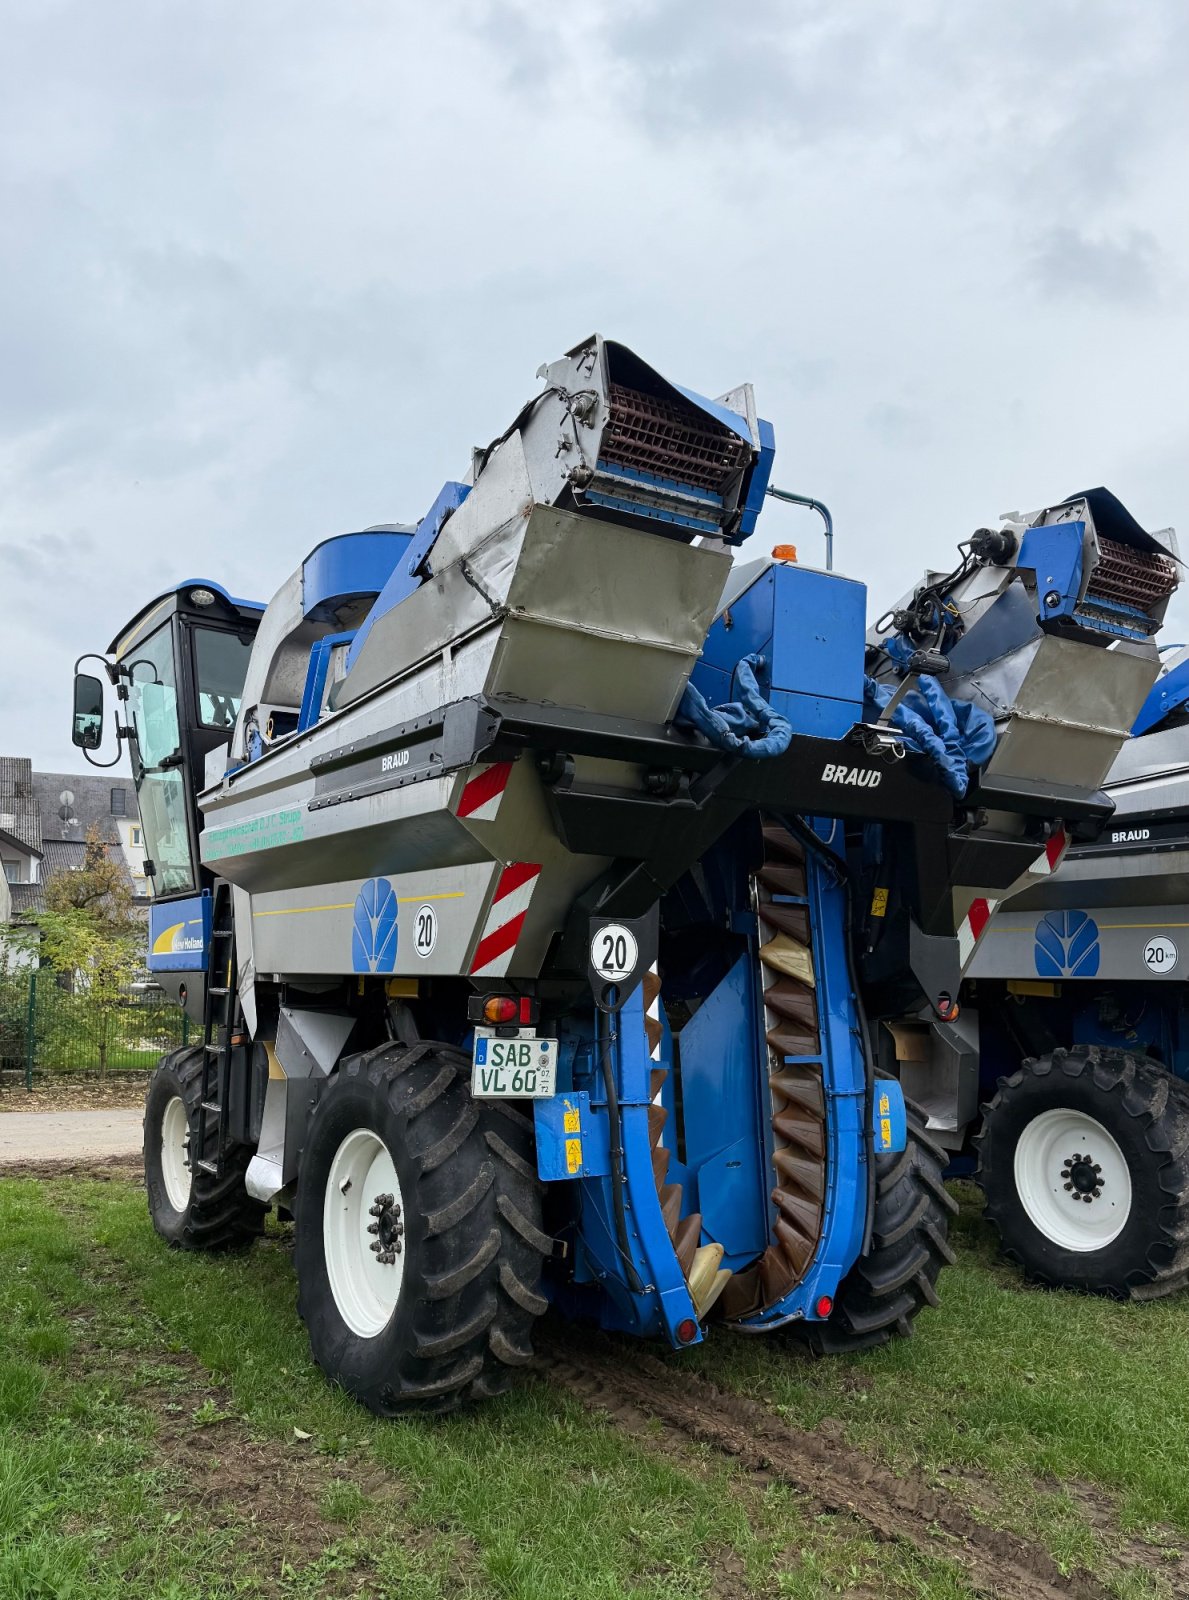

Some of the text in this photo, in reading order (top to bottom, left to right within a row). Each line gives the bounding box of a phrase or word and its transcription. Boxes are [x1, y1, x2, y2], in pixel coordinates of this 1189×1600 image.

[382, 750, 409, 771] BRAUD
[821, 763, 882, 788] BRAUD
[1112, 829, 1149, 843] BRAUD
[418, 914, 433, 947] 20
[184, 936, 203, 950] Holland
[602, 934, 627, 970] 20
[1147, 947, 1164, 963] 20
[491, 1043, 531, 1067] SAB
[481, 1069, 537, 1092] VL 60
